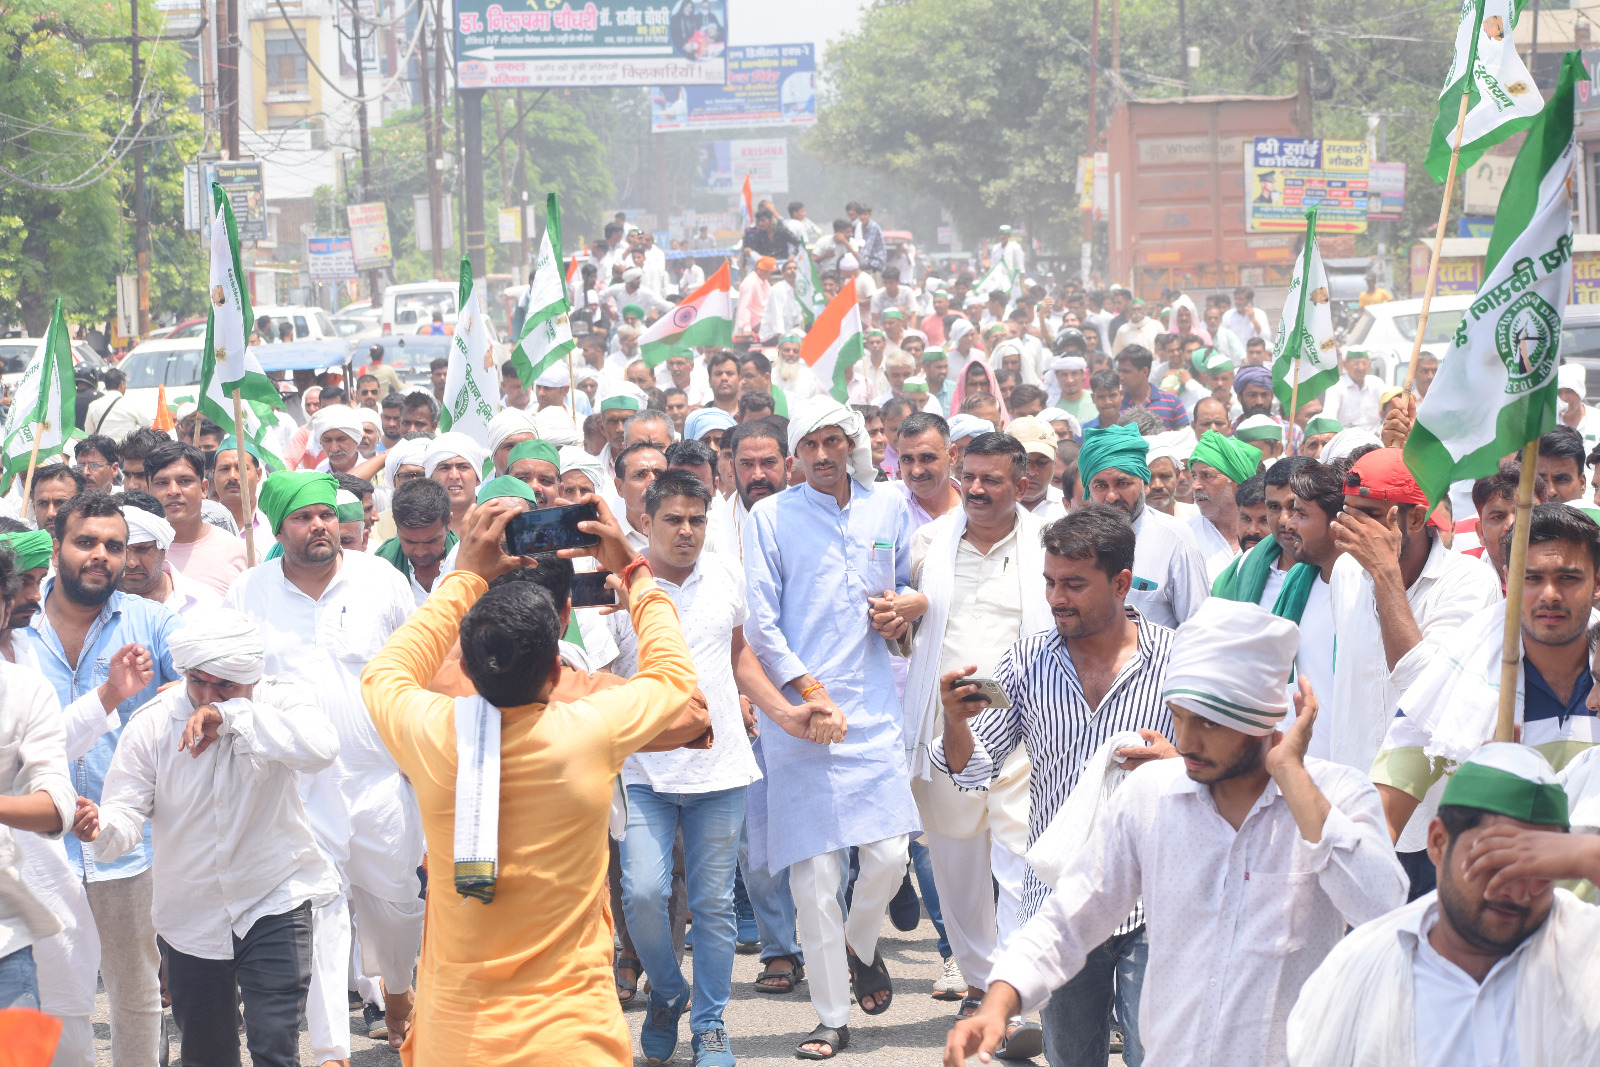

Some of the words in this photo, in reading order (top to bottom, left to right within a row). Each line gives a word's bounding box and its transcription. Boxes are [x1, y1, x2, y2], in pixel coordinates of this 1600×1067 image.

[459, 11, 484, 35] डा.
[487, 4, 551, 32] निरूपमा
[553, 2, 598, 31] चौधरी
[616, 6, 642, 26] राजीव
[644, 6, 670, 26] चौधरी
[486, 35, 499, 45] IVF
[494, 62, 526, 72] सफल
[490, 73, 530, 84] परिणाम
[1474, 63, 1515, 108] यूनियन
[741, 146, 784, 157] KRISHNA
[1256, 138, 1280, 156] श्री
[1326, 142, 1368, 154] सरकारी
[1258, 156, 1317, 169] कोचिंग
[1329, 155, 1364, 167] नौकरी
[219, 169, 236, 177] Curry
[236, 168, 258, 176] Heaven
